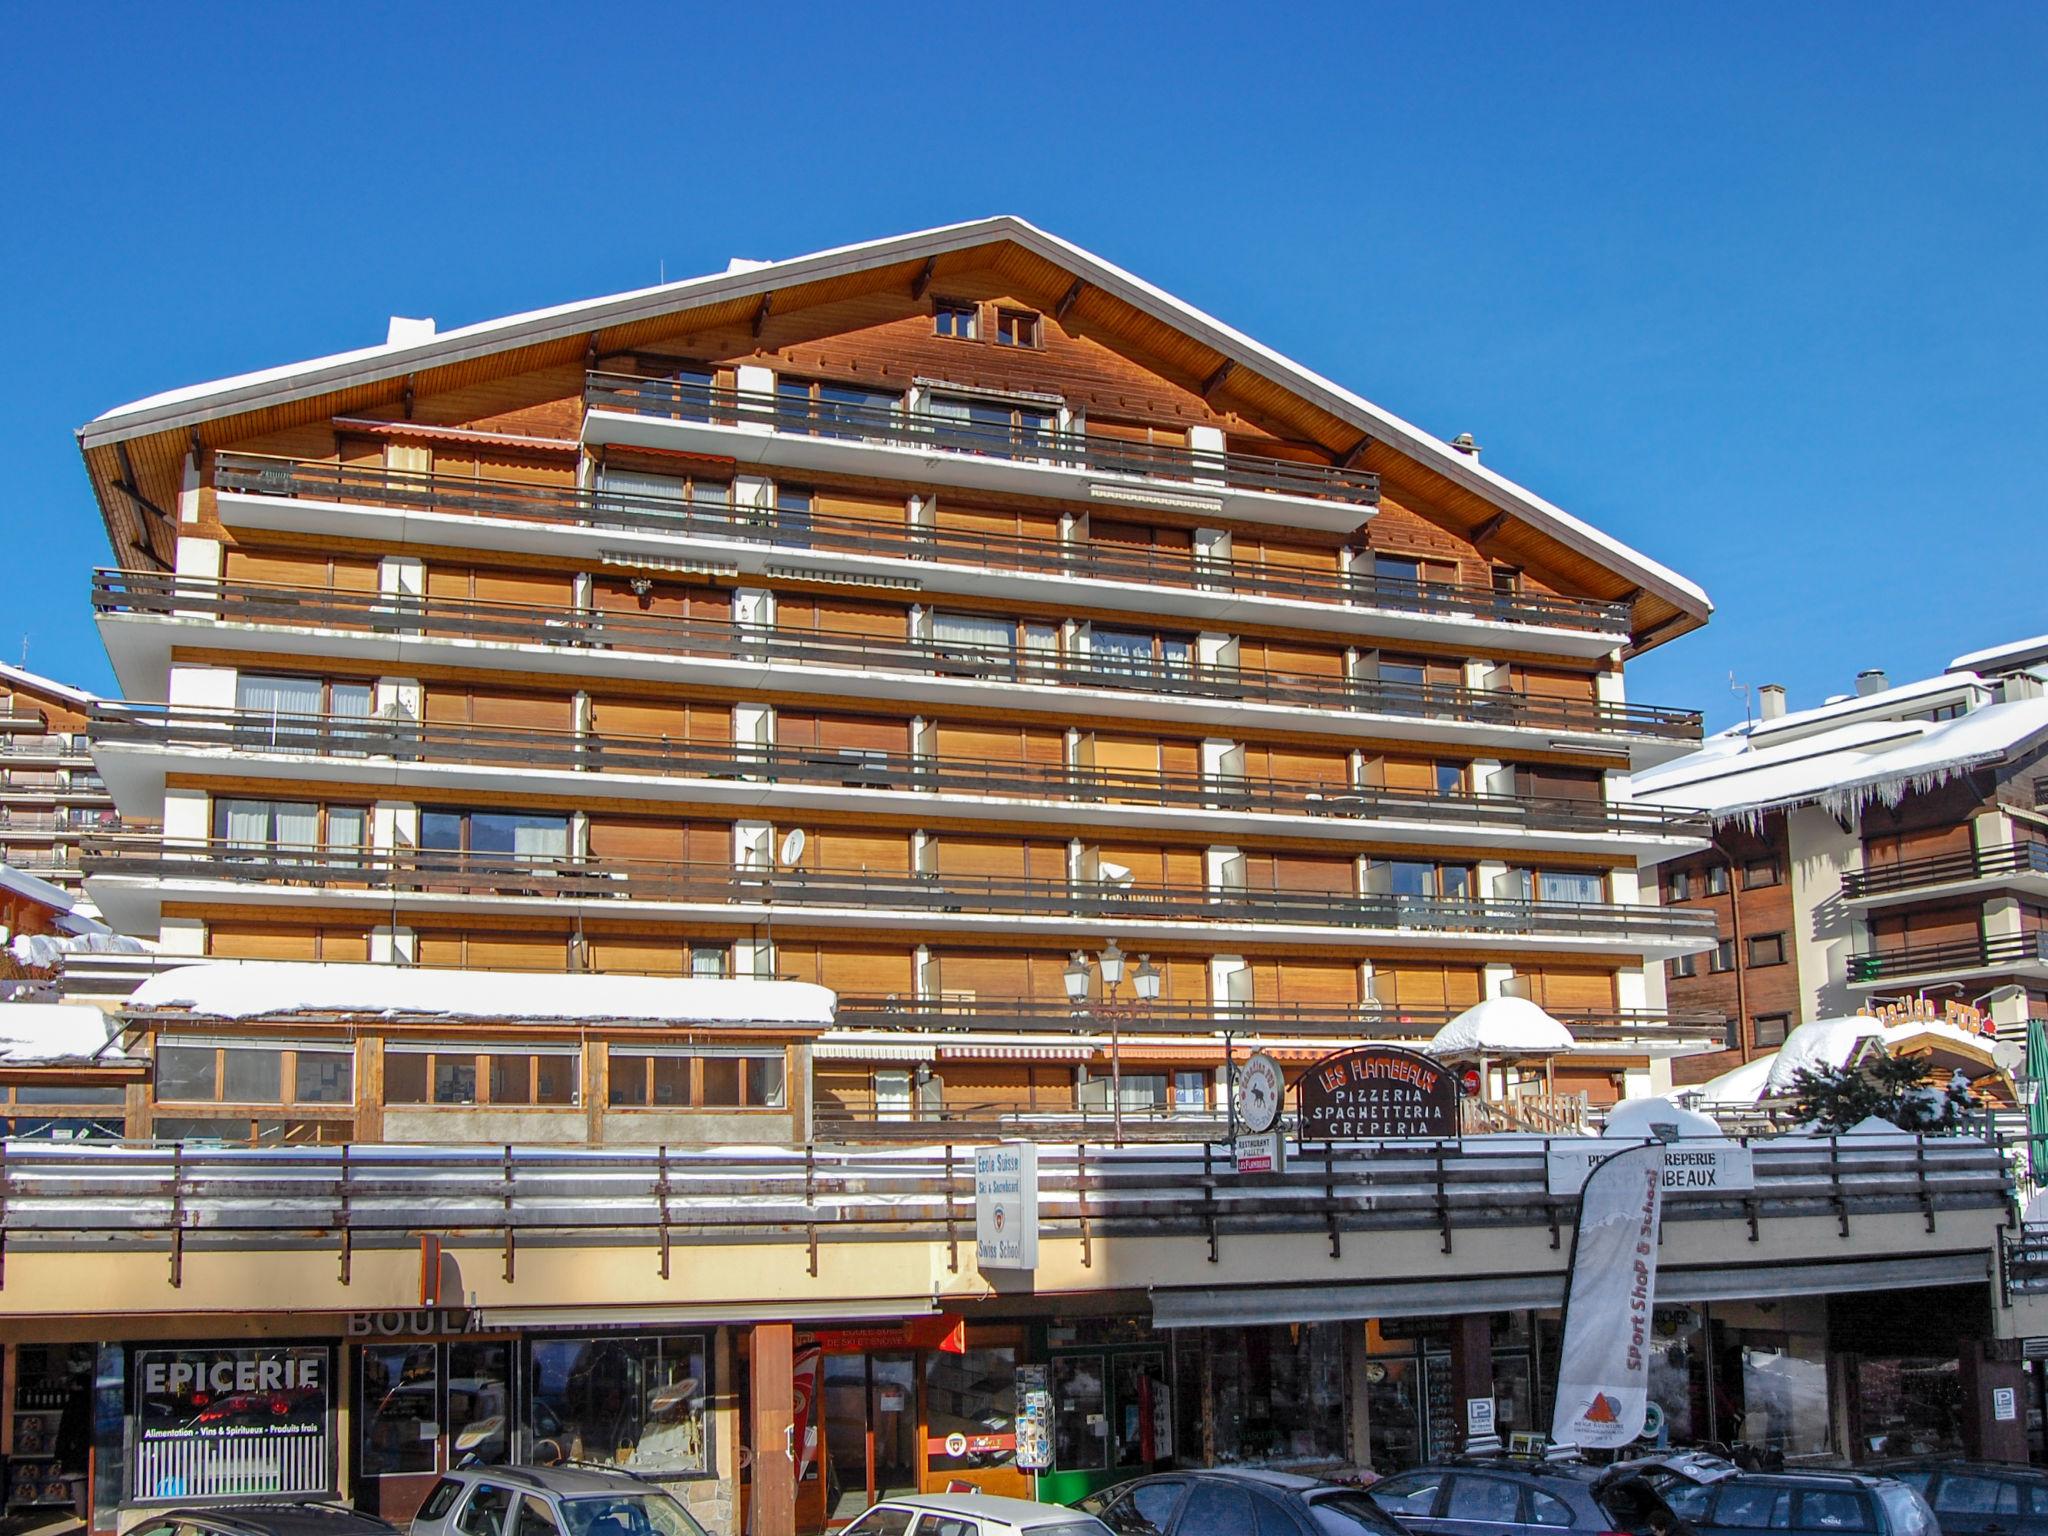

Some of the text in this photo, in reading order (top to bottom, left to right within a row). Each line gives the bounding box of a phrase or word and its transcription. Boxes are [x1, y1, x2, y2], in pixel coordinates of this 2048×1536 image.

[1319, 1056, 1438, 1094] LES FLAMBEAUX
[1335, 1089, 1422, 1104] PIZZERIA
[1312, 1105, 1442, 1120] SPAGHETTERIA
[1329, 1121, 1428, 1135] CREPERIA
[1238, 1138, 1270, 1149] RESTAURANT
[997, 1153, 1019, 1172] Suisse
[1664, 1152, 1716, 1167] REPERIE
[1662, 1168, 1717, 1187] BEAUX
[993, 1180, 1019, 1195] Snowboard
[978, 1240, 1021, 1260] Swiss School
[1629, 1259, 1649, 1313] Shop
[1626, 1314, 1645, 1371] Sport
[146, 1360, 319, 1393] EPICERIE
[145, 1428, 193, 1438] Alimentation
[201, 1427, 217, 1436] Vins
[218, 1427, 224, 1435] &
[226, 1426, 264, 1437] Spiritueux
[269, 1424, 300, 1434] Produits
[301, 1423, 318, 1433] frais
